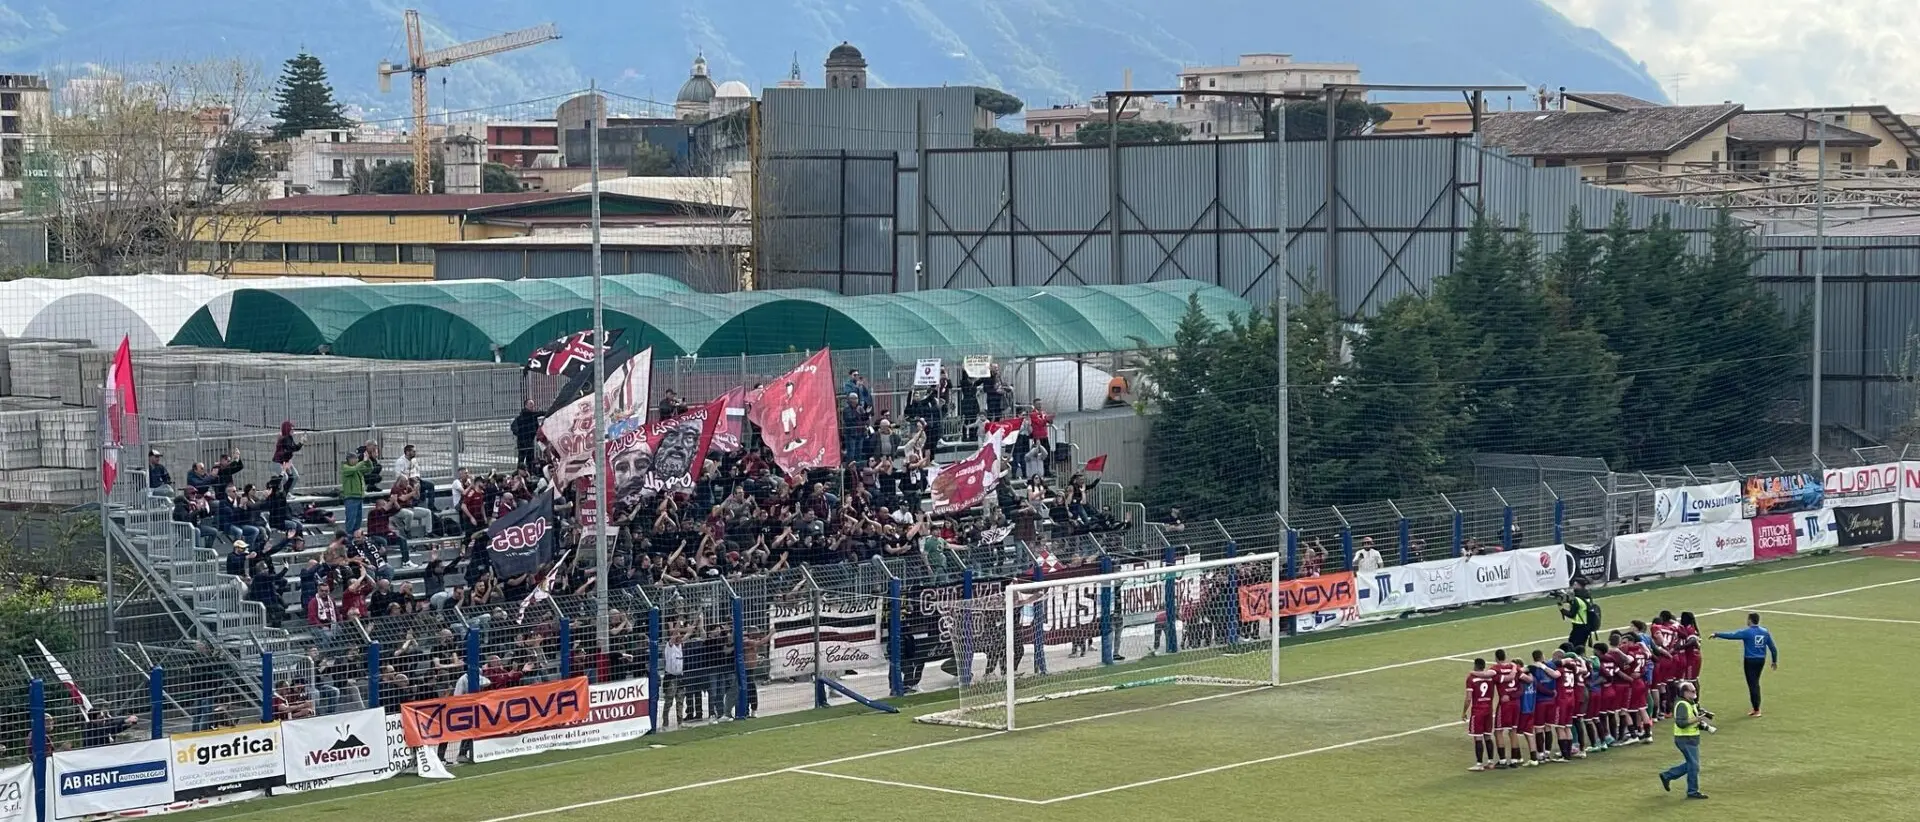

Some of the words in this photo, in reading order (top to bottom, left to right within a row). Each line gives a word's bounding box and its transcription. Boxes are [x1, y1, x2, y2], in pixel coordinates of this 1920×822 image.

[1692, 494, 1742, 510] CONSULTING
[1268, 581, 1351, 611] GIVOVA
[1430, 582, 1455, 594] GARE
[825, 645, 870, 663] Calabria
[590, 684, 645, 704] ETWORK
[1480, 682, 1489, 697] 9
[446, 690, 580, 732] GIVOVA
[596, 705, 636, 720] VUOLO
[577, 728, 600, 738] Lavoro
[63, 776, 82, 790] AB
[84, 771, 120, 787] RENT
[119, 769, 166, 782] AUTONOLEGGIO
